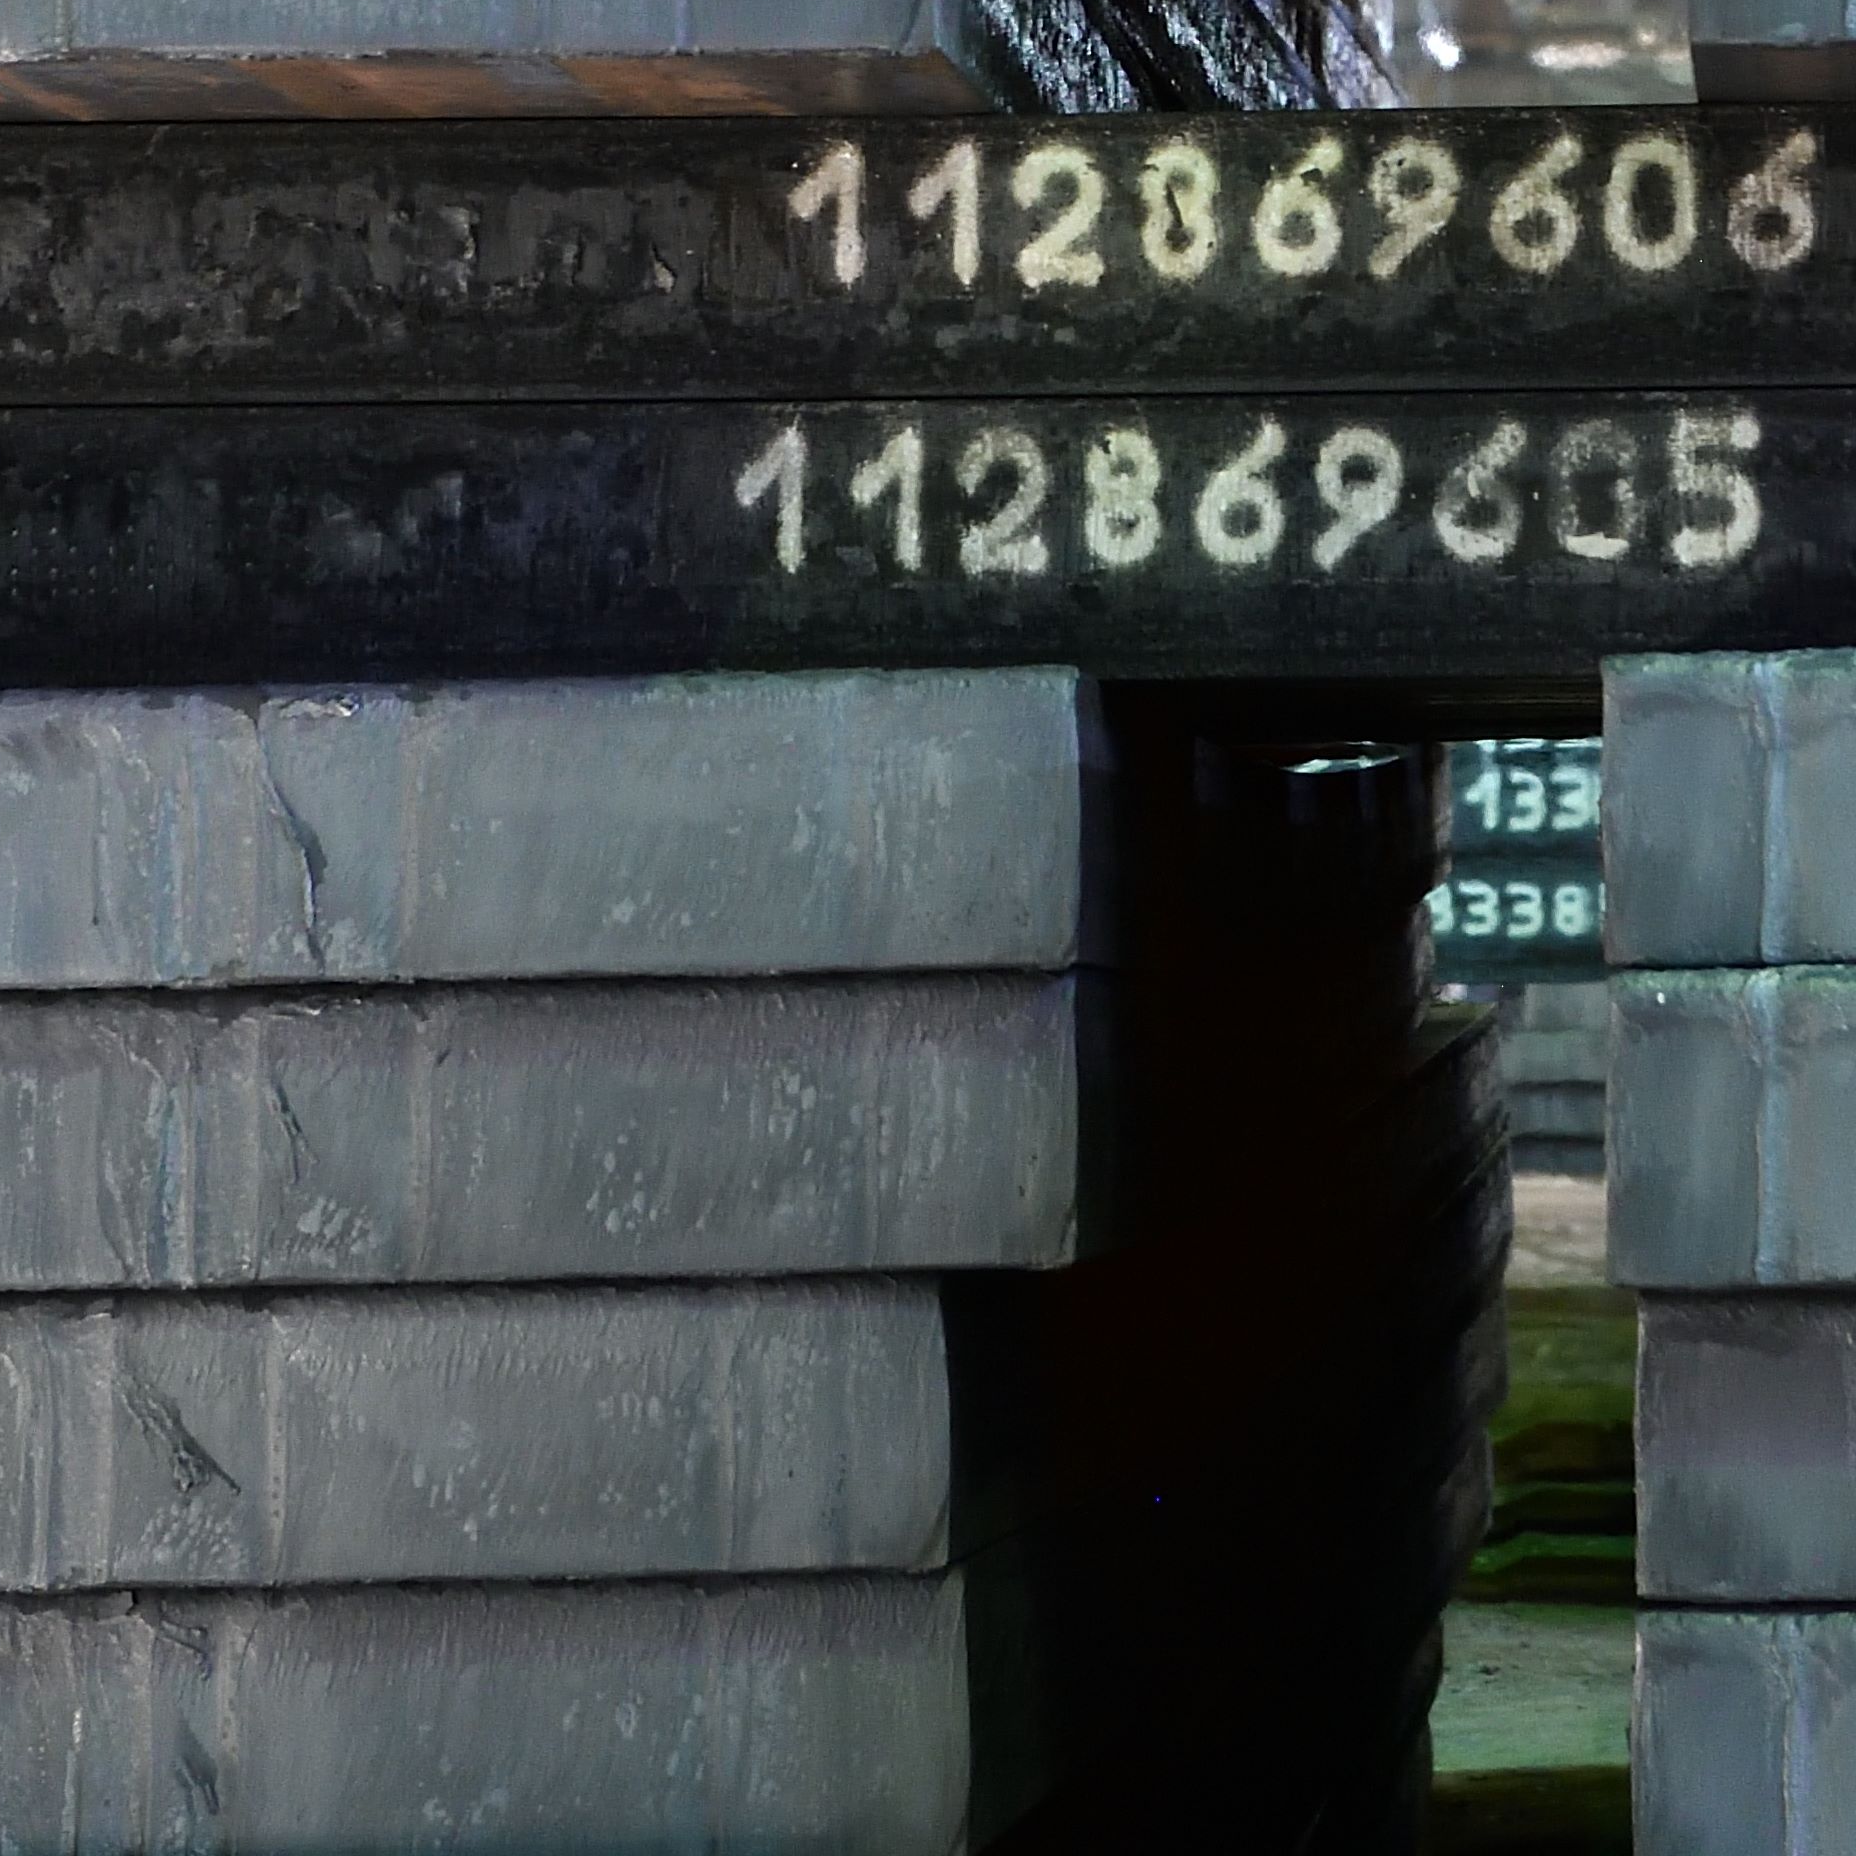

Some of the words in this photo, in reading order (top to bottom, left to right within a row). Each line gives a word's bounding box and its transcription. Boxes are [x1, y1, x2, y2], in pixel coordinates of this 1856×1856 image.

[788, 128, 1817, 294] 112869606
[734, 410, 1762, 575] 112869605
[1464, 764, 1601, 832] 133
